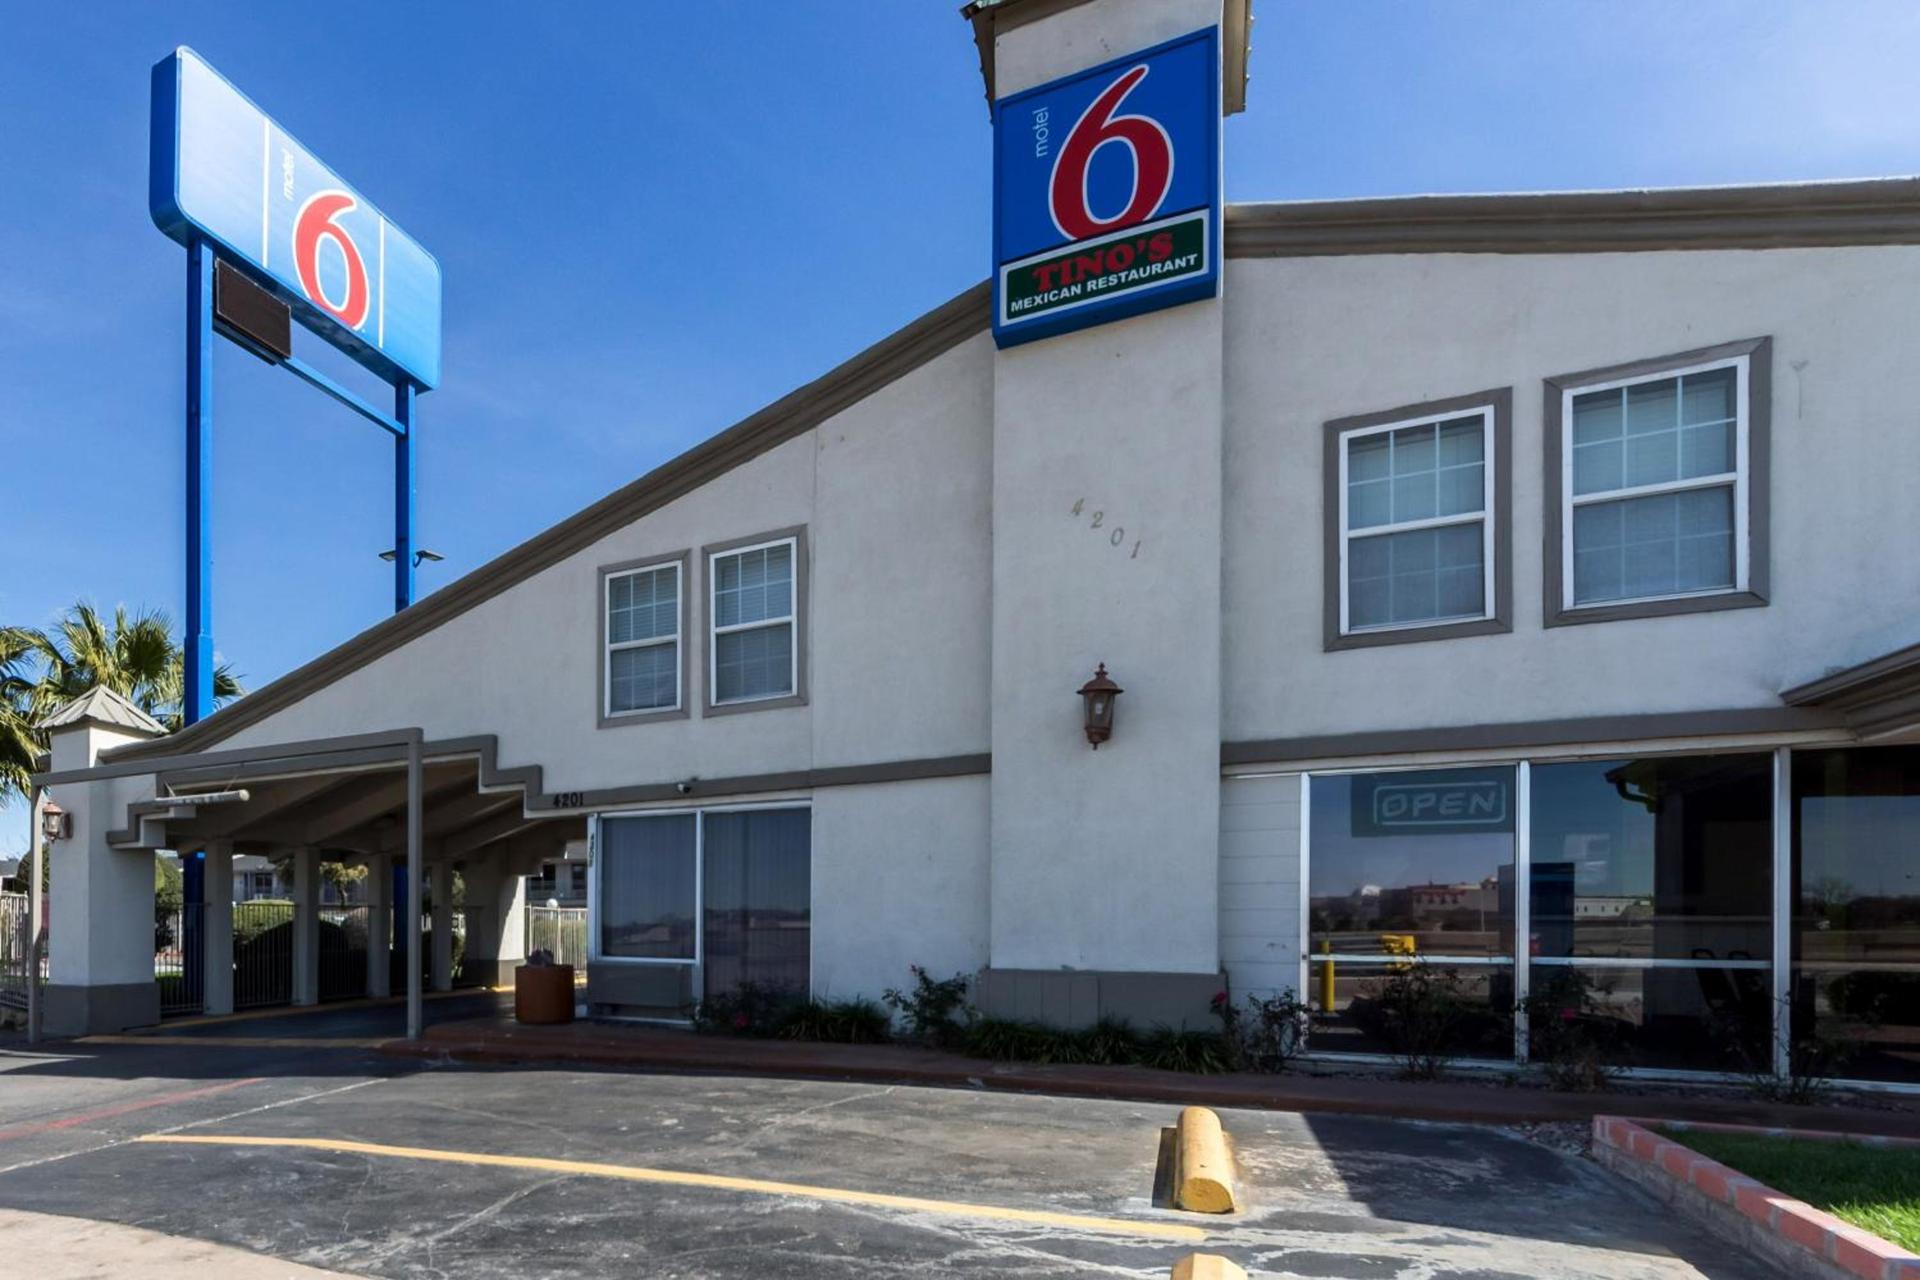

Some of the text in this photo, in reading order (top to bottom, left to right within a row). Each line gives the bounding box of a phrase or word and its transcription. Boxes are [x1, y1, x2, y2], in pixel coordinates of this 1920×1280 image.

[1032, 64, 1174, 241] motel 6
[281, 148, 370, 331] motel 6
[1032, 232, 1174, 291] TINO'S
[1010, 253, 1199, 312] MEXICAN RESTAURANT
[1070, 497, 1141, 559] 4201
[553, 792, 584, 808] 4201
[1382, 791, 1496, 817] OPEN
